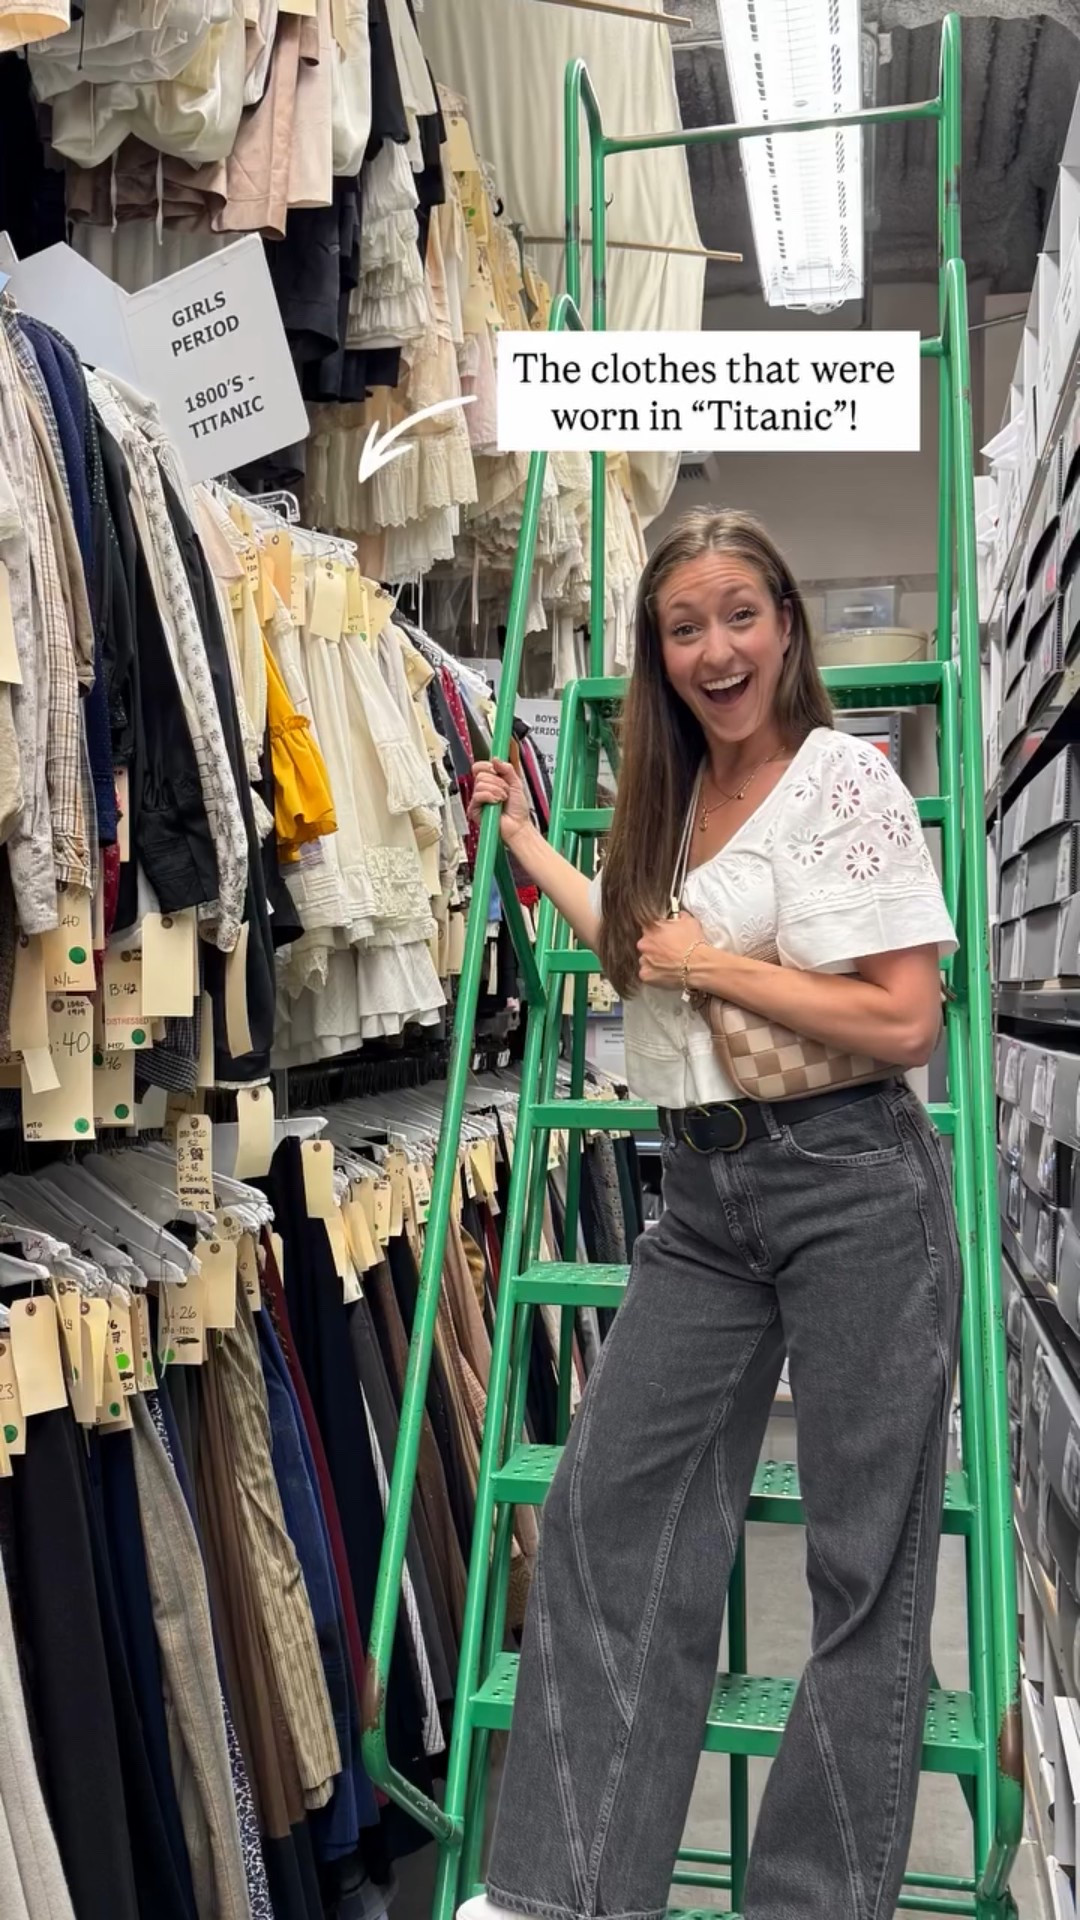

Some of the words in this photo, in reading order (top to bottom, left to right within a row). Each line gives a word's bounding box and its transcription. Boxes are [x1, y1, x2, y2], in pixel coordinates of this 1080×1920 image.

[171, 291, 227, 328] GIRLS
[171, 315, 240, 358] PERIOD
[184, 375, 244, 414] 1800'S
[188, 395, 265, 439] TITANIC
[535, 714, 559, 724] BOYS
[106, 1016, 150, 1026] DISTRESSED
[49, 1030, 91, 1057] :40
